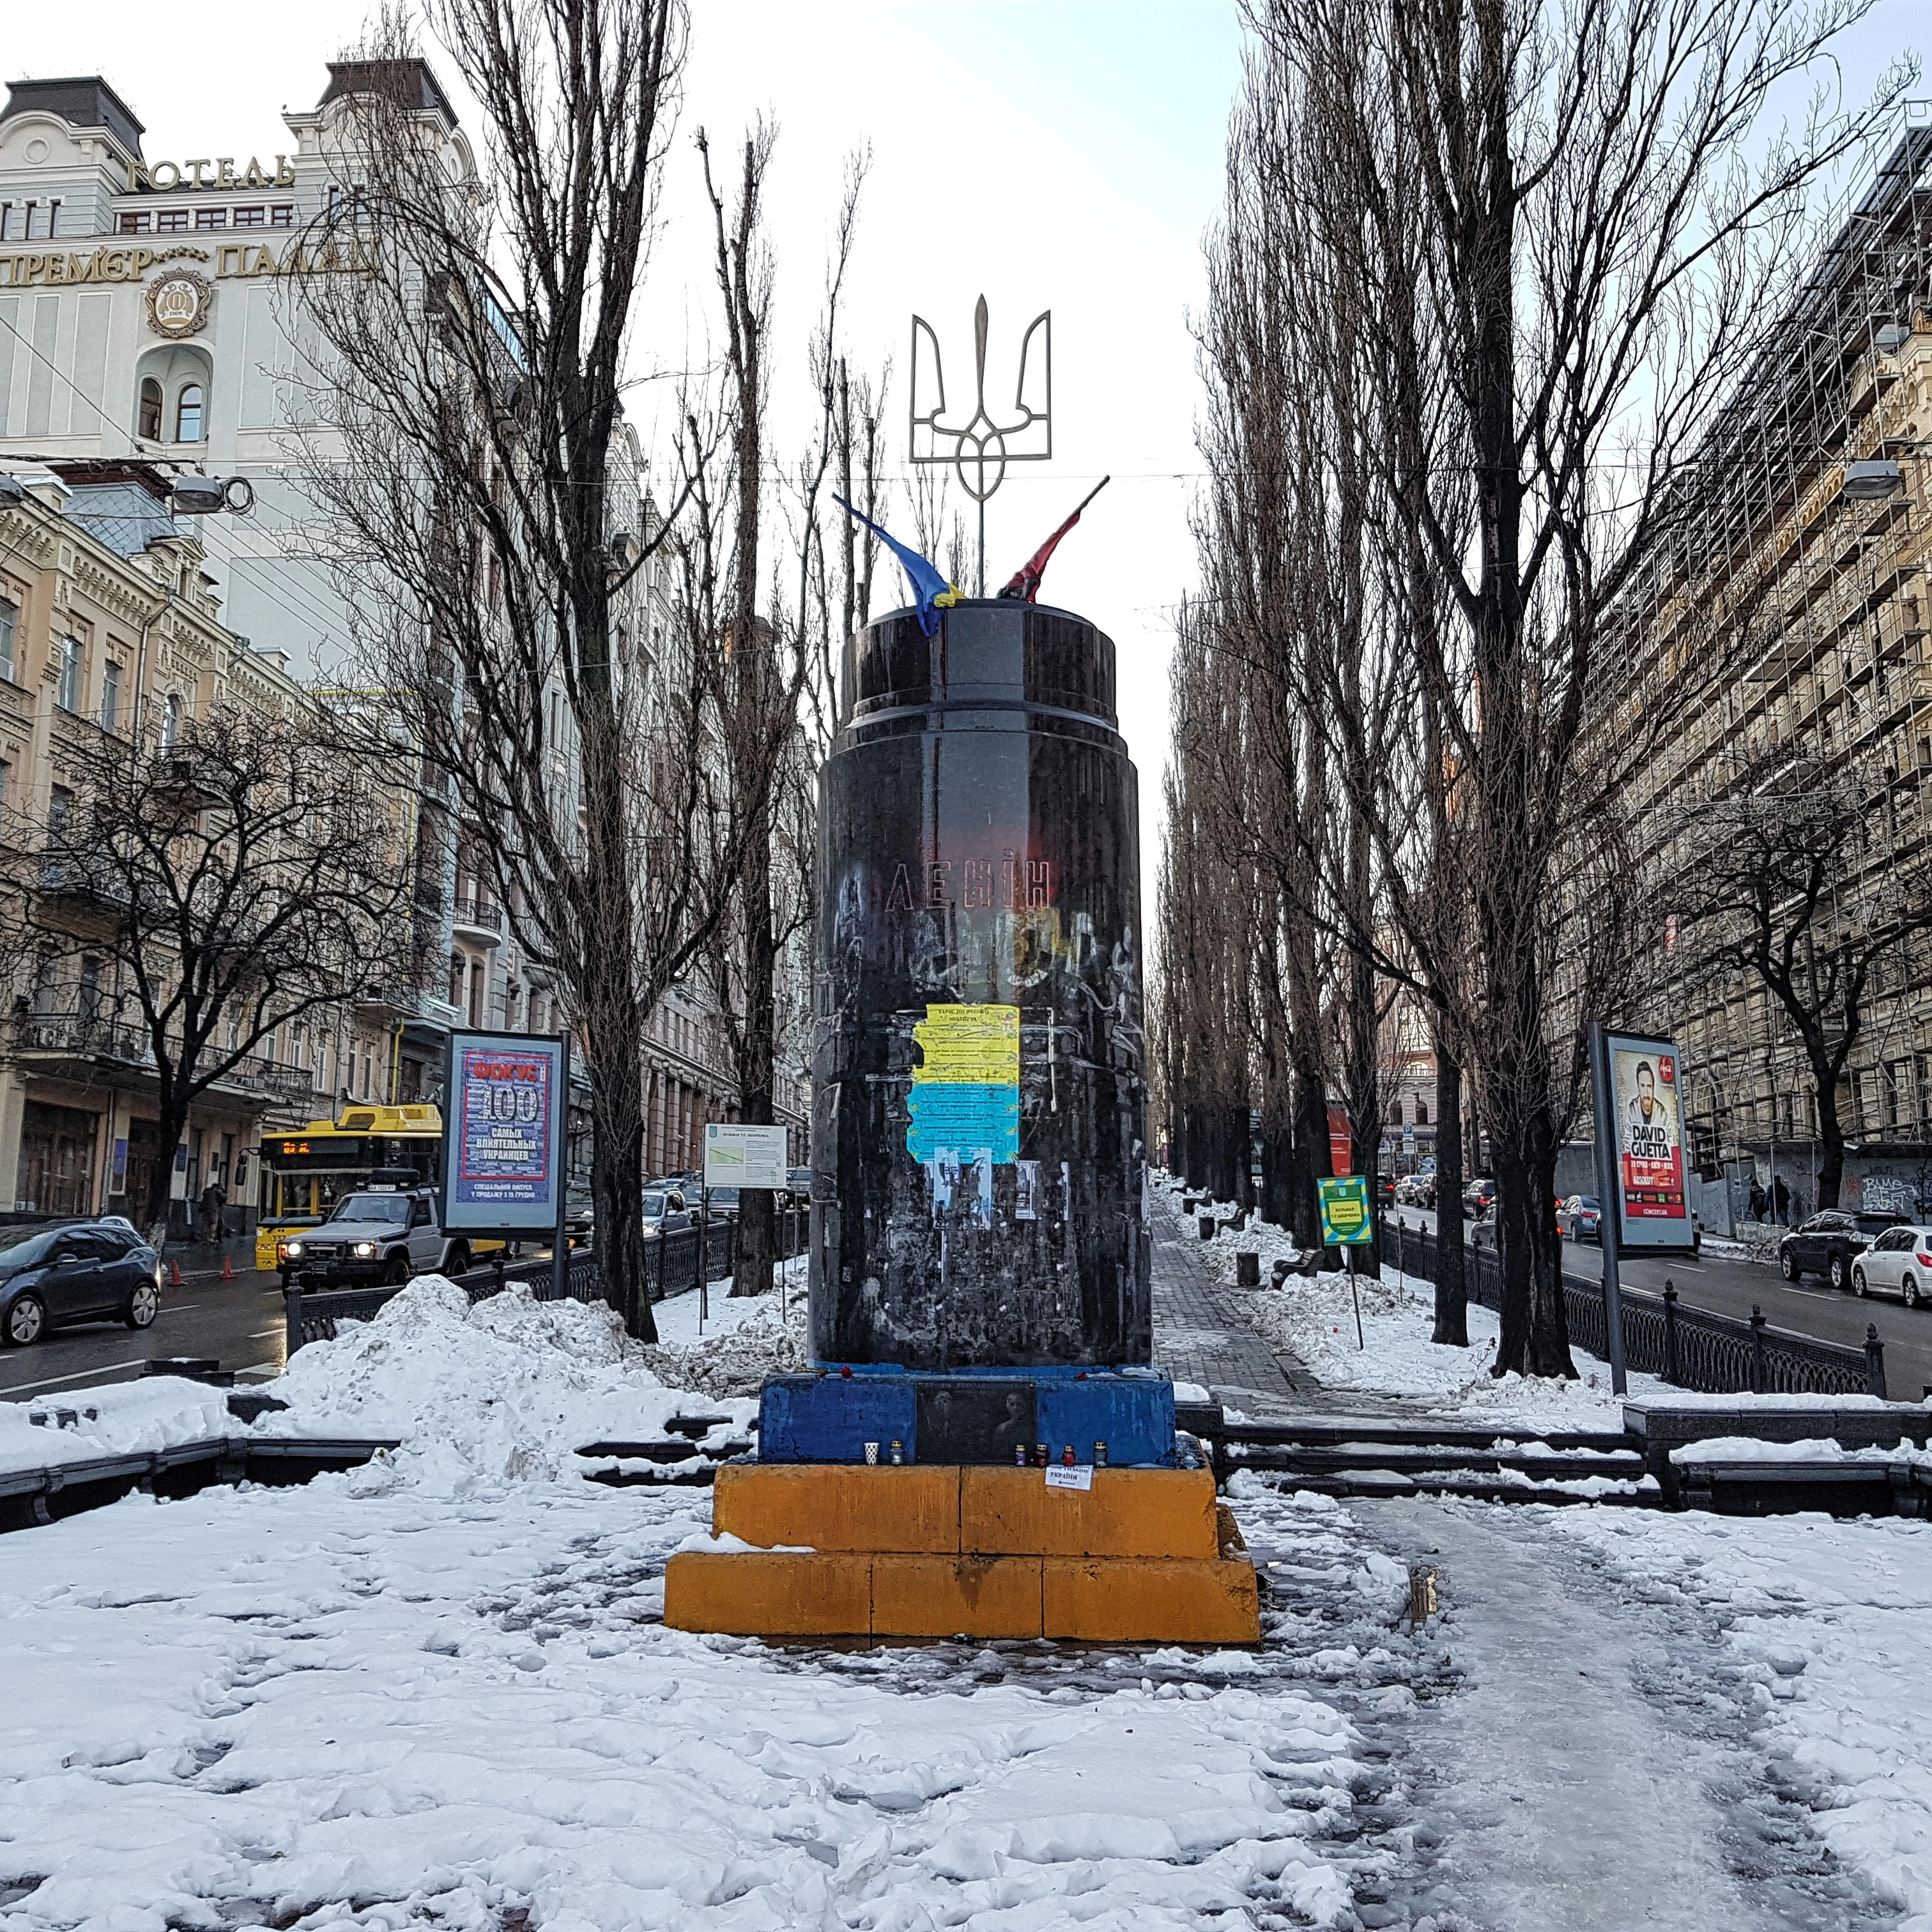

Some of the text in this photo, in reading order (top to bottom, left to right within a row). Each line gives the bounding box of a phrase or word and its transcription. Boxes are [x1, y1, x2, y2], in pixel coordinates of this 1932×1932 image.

[125, 155, 294, 192] ГОТЕЛЬ
[885, 848, 1049, 912] ЛЕНІН
[473, 1062, 539, 1082] ФОКУС
[478, 1086, 537, 1122] 100
[491, 1128, 523, 1138] САМЫХ
[1632, 1124, 1666, 1142] DAVID
[476, 1138, 537, 1149] ВЛИЯТЕЛЬНЫХ
[1631, 1142, 1671, 1158] GUETTA
[483, 1149, 529, 1161] УКРАИНЦЕВ
[1050, 1472, 1077, 1480] УКРАЇНИ
